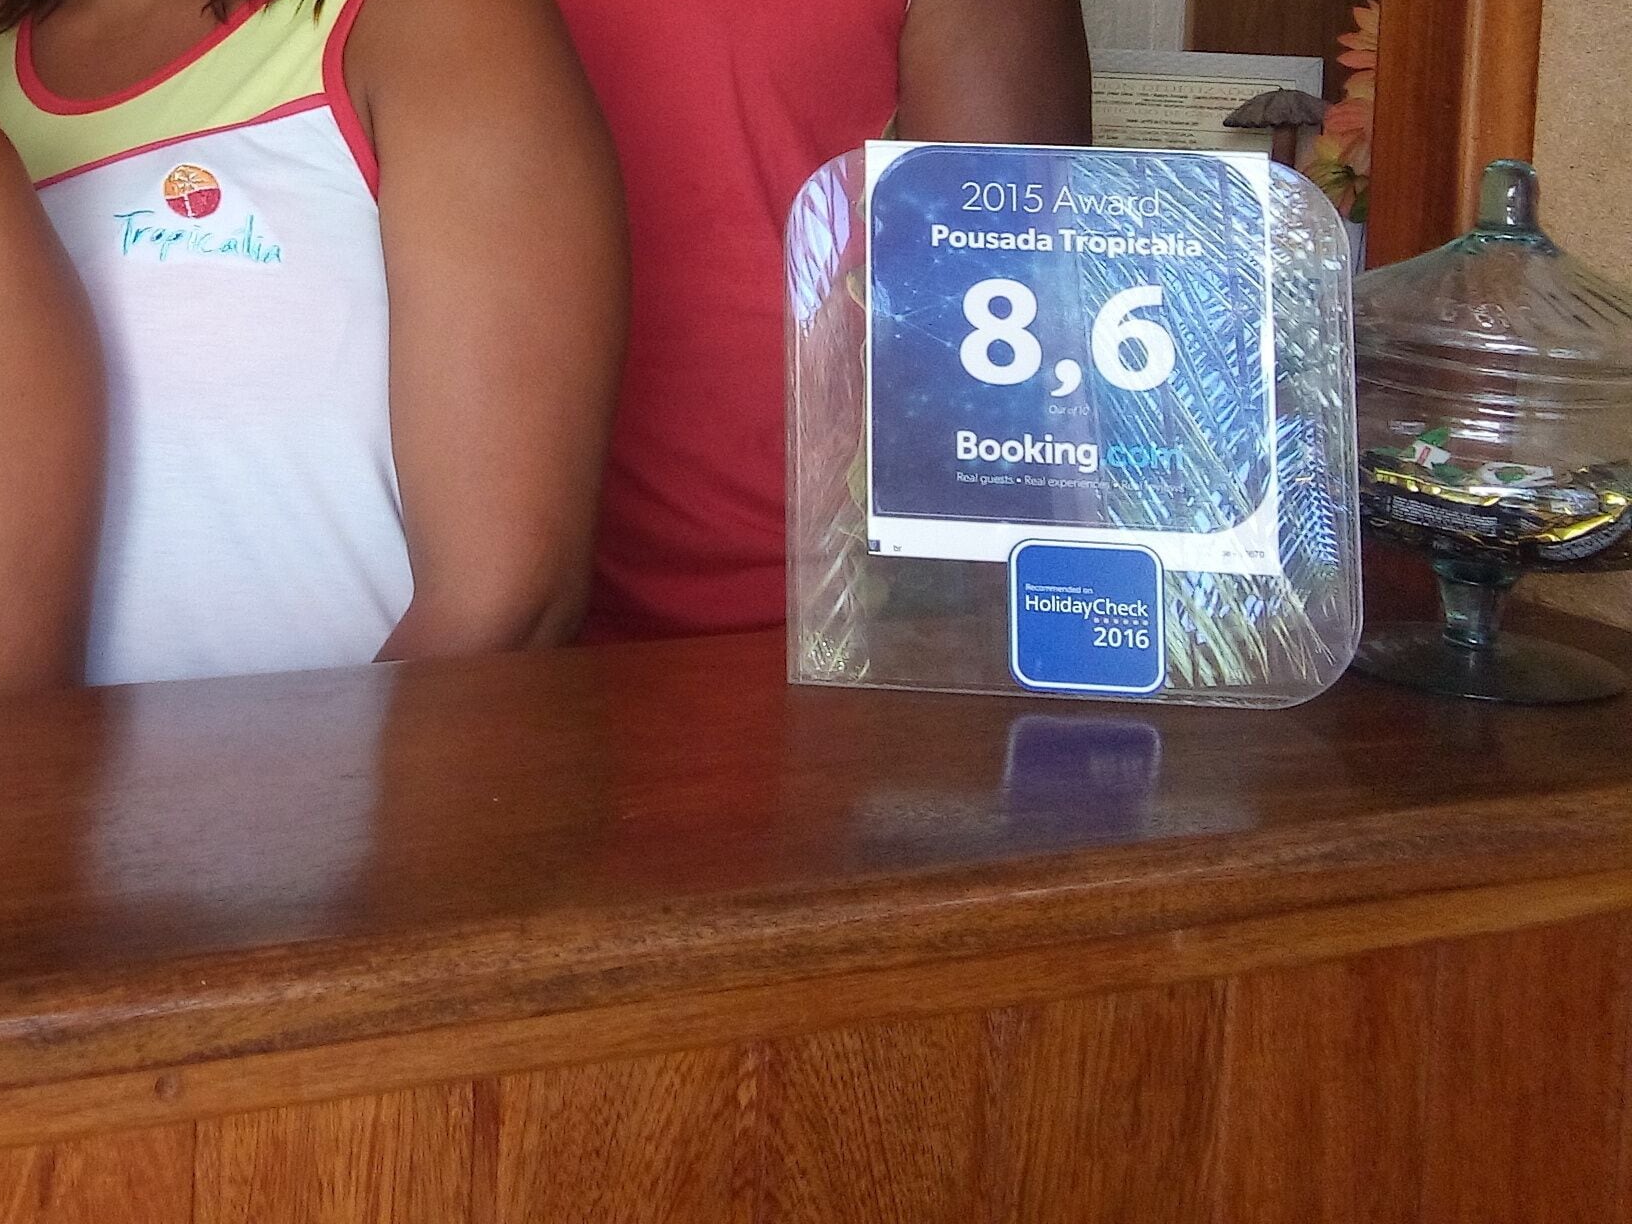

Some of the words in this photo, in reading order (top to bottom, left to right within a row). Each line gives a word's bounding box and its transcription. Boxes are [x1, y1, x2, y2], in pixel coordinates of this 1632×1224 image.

[961, 182, 1044, 213] 2015
[1052, 185, 1161, 218] Award
[930, 224, 1054, 252] Pousada
[959, 278, 1176, 398] 8,6
[956, 471, 979, 483] Real
[979, 475, 1015, 486] guests
[1024, 474, 1046, 487] Real
[1024, 583, 1082, 594] Recommended
[1083, 586, 1094, 595] on
[1024, 594, 1148, 619] HolidayCheck
[1093, 626, 1150, 649] 2016
